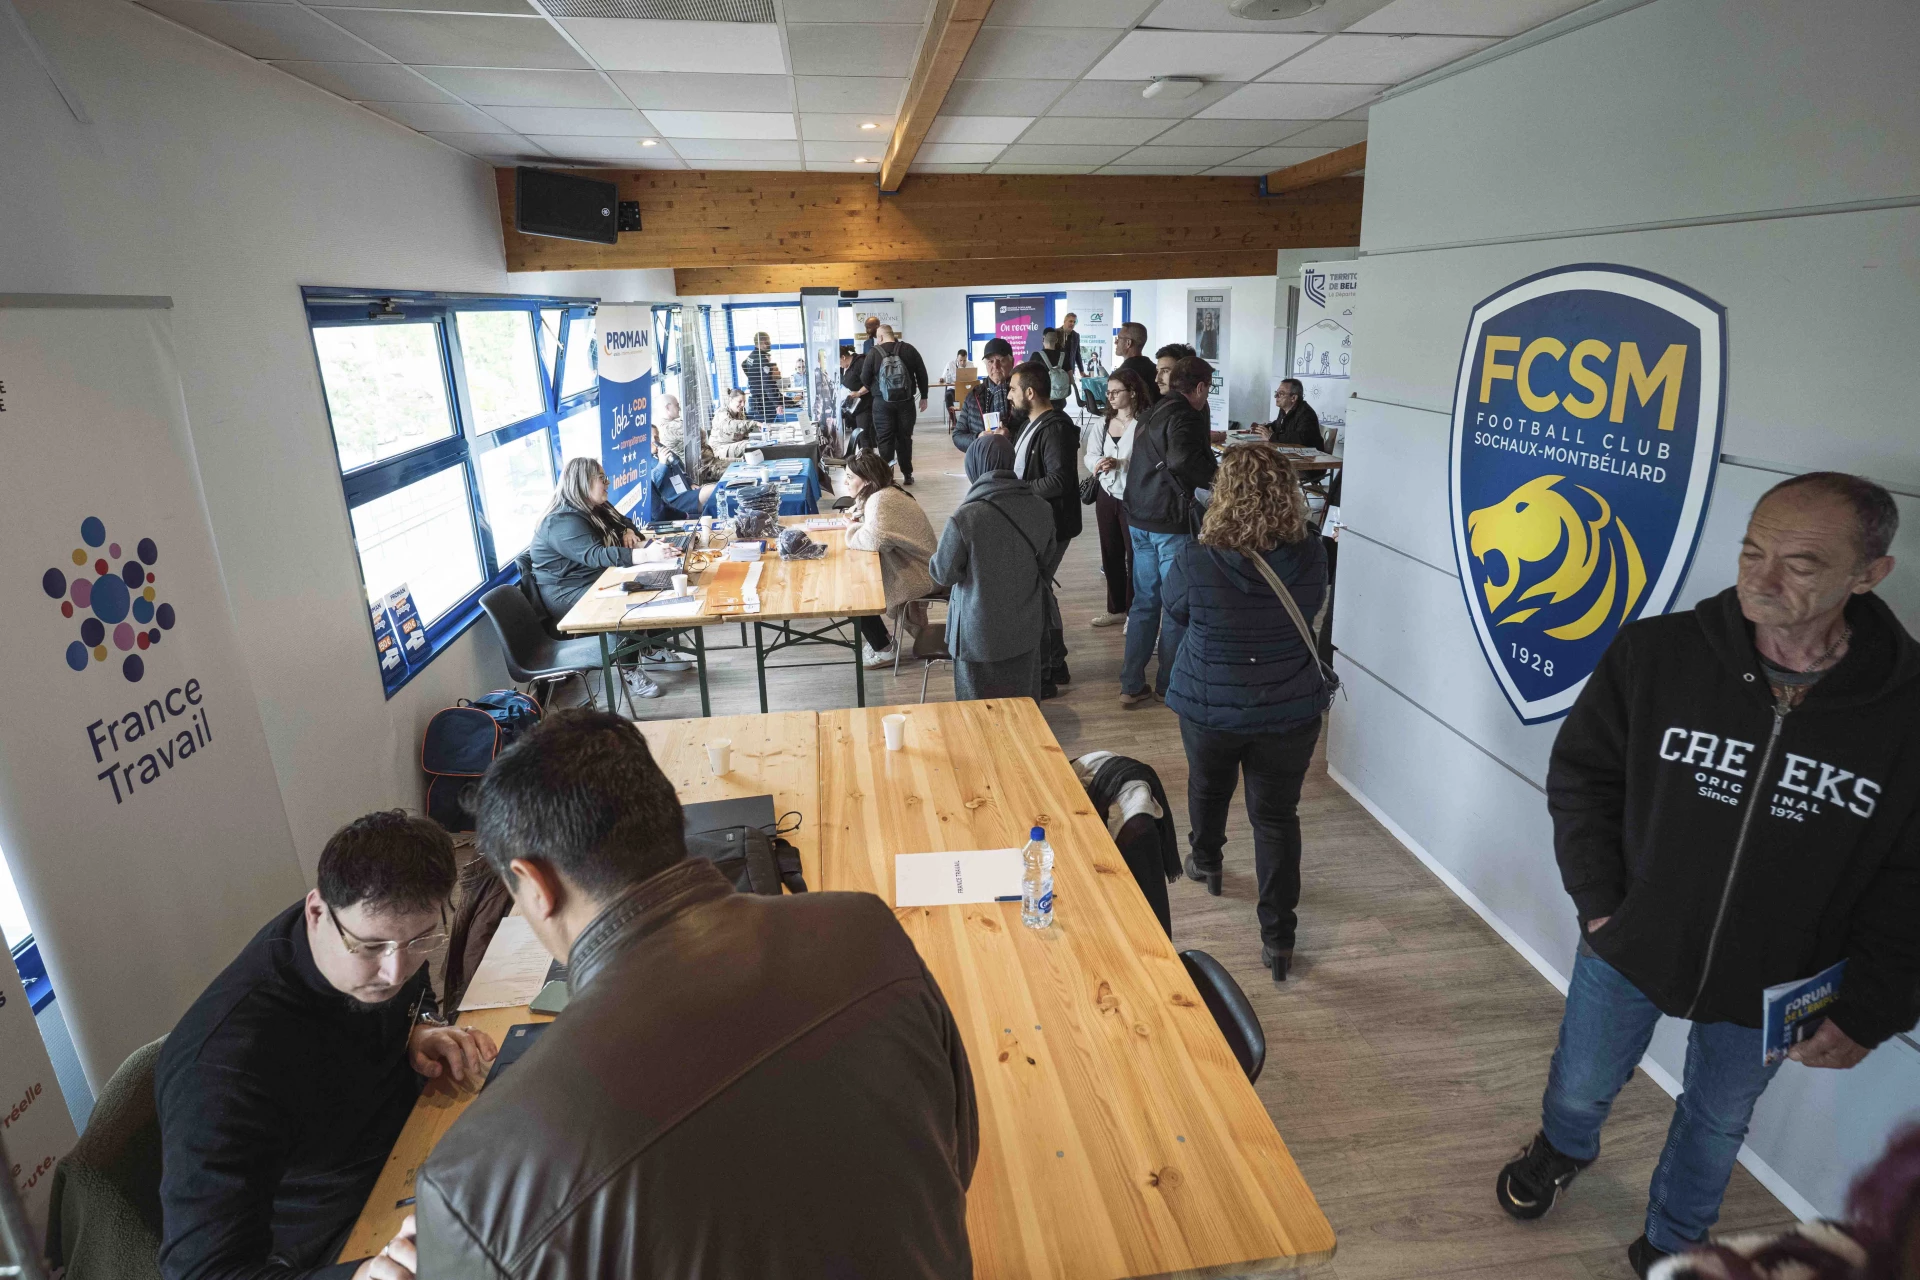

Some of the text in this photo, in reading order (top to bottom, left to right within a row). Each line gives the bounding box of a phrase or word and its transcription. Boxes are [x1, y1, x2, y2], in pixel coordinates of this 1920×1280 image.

[1329, 282, 1339, 290] DE
[1330, 272, 1357, 281] TERRITO
[606, 329, 648, 350] PROMAN
[1000, 321, 1039, 332] On recrute
[1479, 335, 1688, 431] FCSM
[632, 398, 647, 411] CDD
[635, 413, 647, 427] CDI
[1476, 412, 1671, 460] FOOTBALL CLUB
[1474, 431, 1667, 483] SOCHAUX-MONTBÉLIARD
[612, 467, 638, 490] intérim
[1510, 642, 1555, 678] 1928
[86, 678, 203, 763] France
[97, 708, 213, 805] Travail
[1698, 786, 1804, 822] Since 1974
[955, 878, 963, 894] FRANCE
[1785, 982, 1832, 1015] FORUM
[4, 1082, 43, 1129] réelle
[22, 1155, 56, 1189] ute.
